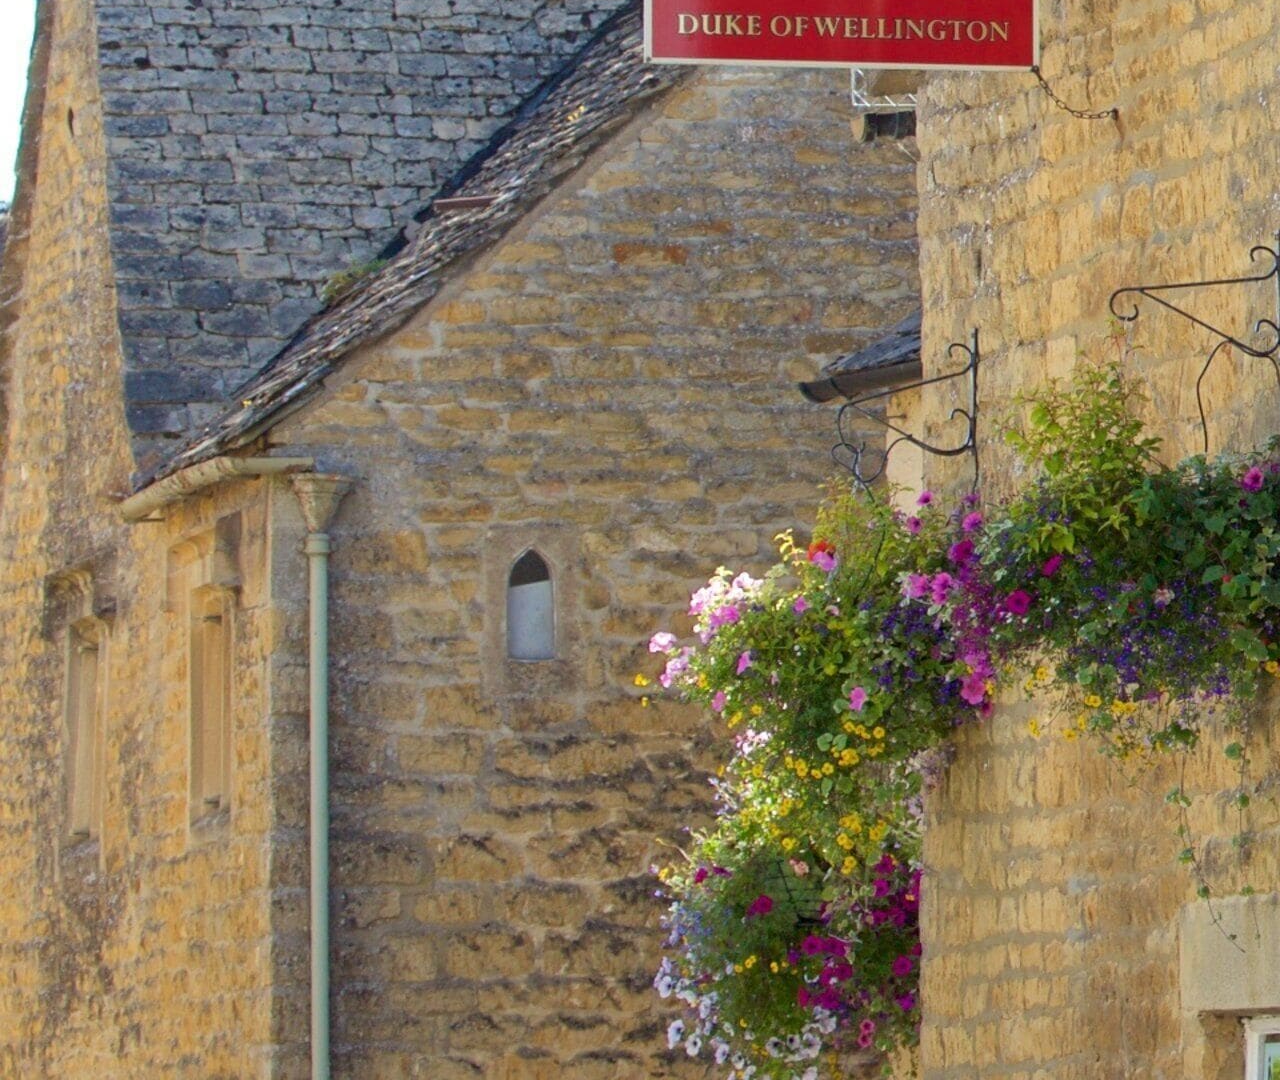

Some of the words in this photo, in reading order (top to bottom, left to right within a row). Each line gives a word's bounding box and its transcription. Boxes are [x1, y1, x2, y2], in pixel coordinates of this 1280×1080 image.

[677, 12, 762, 36] DUKE
[769, 16, 809, 39] OF
[814, 16, 1009, 42] WELLINGTON
